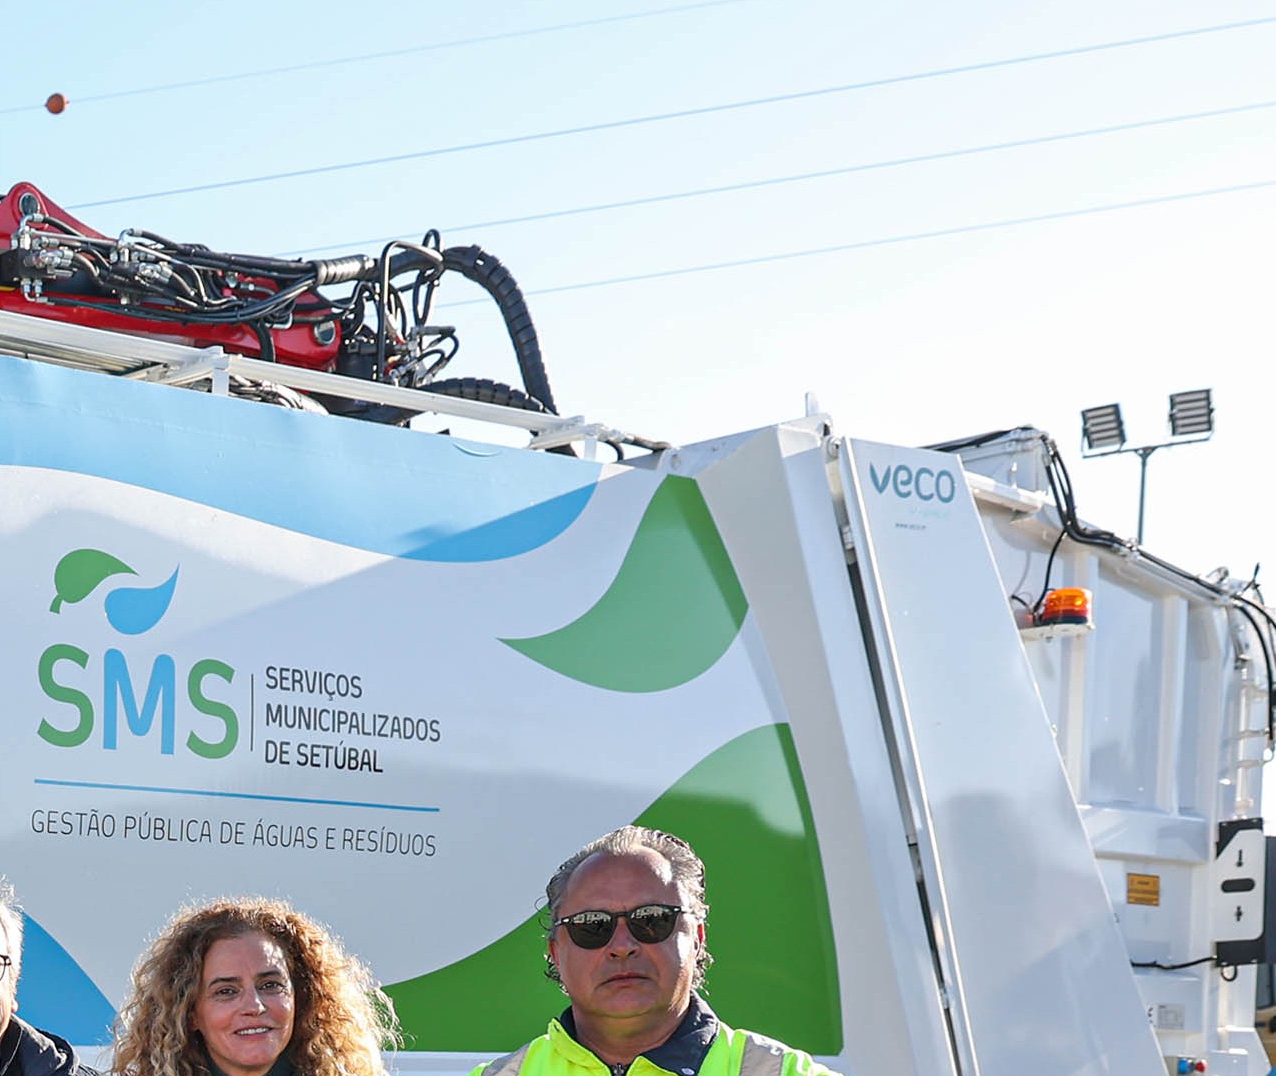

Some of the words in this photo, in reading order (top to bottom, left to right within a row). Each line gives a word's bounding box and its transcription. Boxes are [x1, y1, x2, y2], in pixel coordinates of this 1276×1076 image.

[869, 461, 956, 504] veco
[37, 643, 239, 760] SMS
[265, 665, 363, 701] SERVIÇOS
[266, 703, 441, 742] MUNICIPALIZADOS
[265, 740, 291, 765] DE
[296, 740, 384, 773] SETÚBAL
[31, 808, 116, 838] GESTÃO
[123, 811, 212, 843] PÚBLICA
[219, 821, 246, 845] DE
[252, 818, 318, 849] ÁGUAS
[325, 827, 336, 849] E
[342, 826, 436, 857] RESÍDUOS
